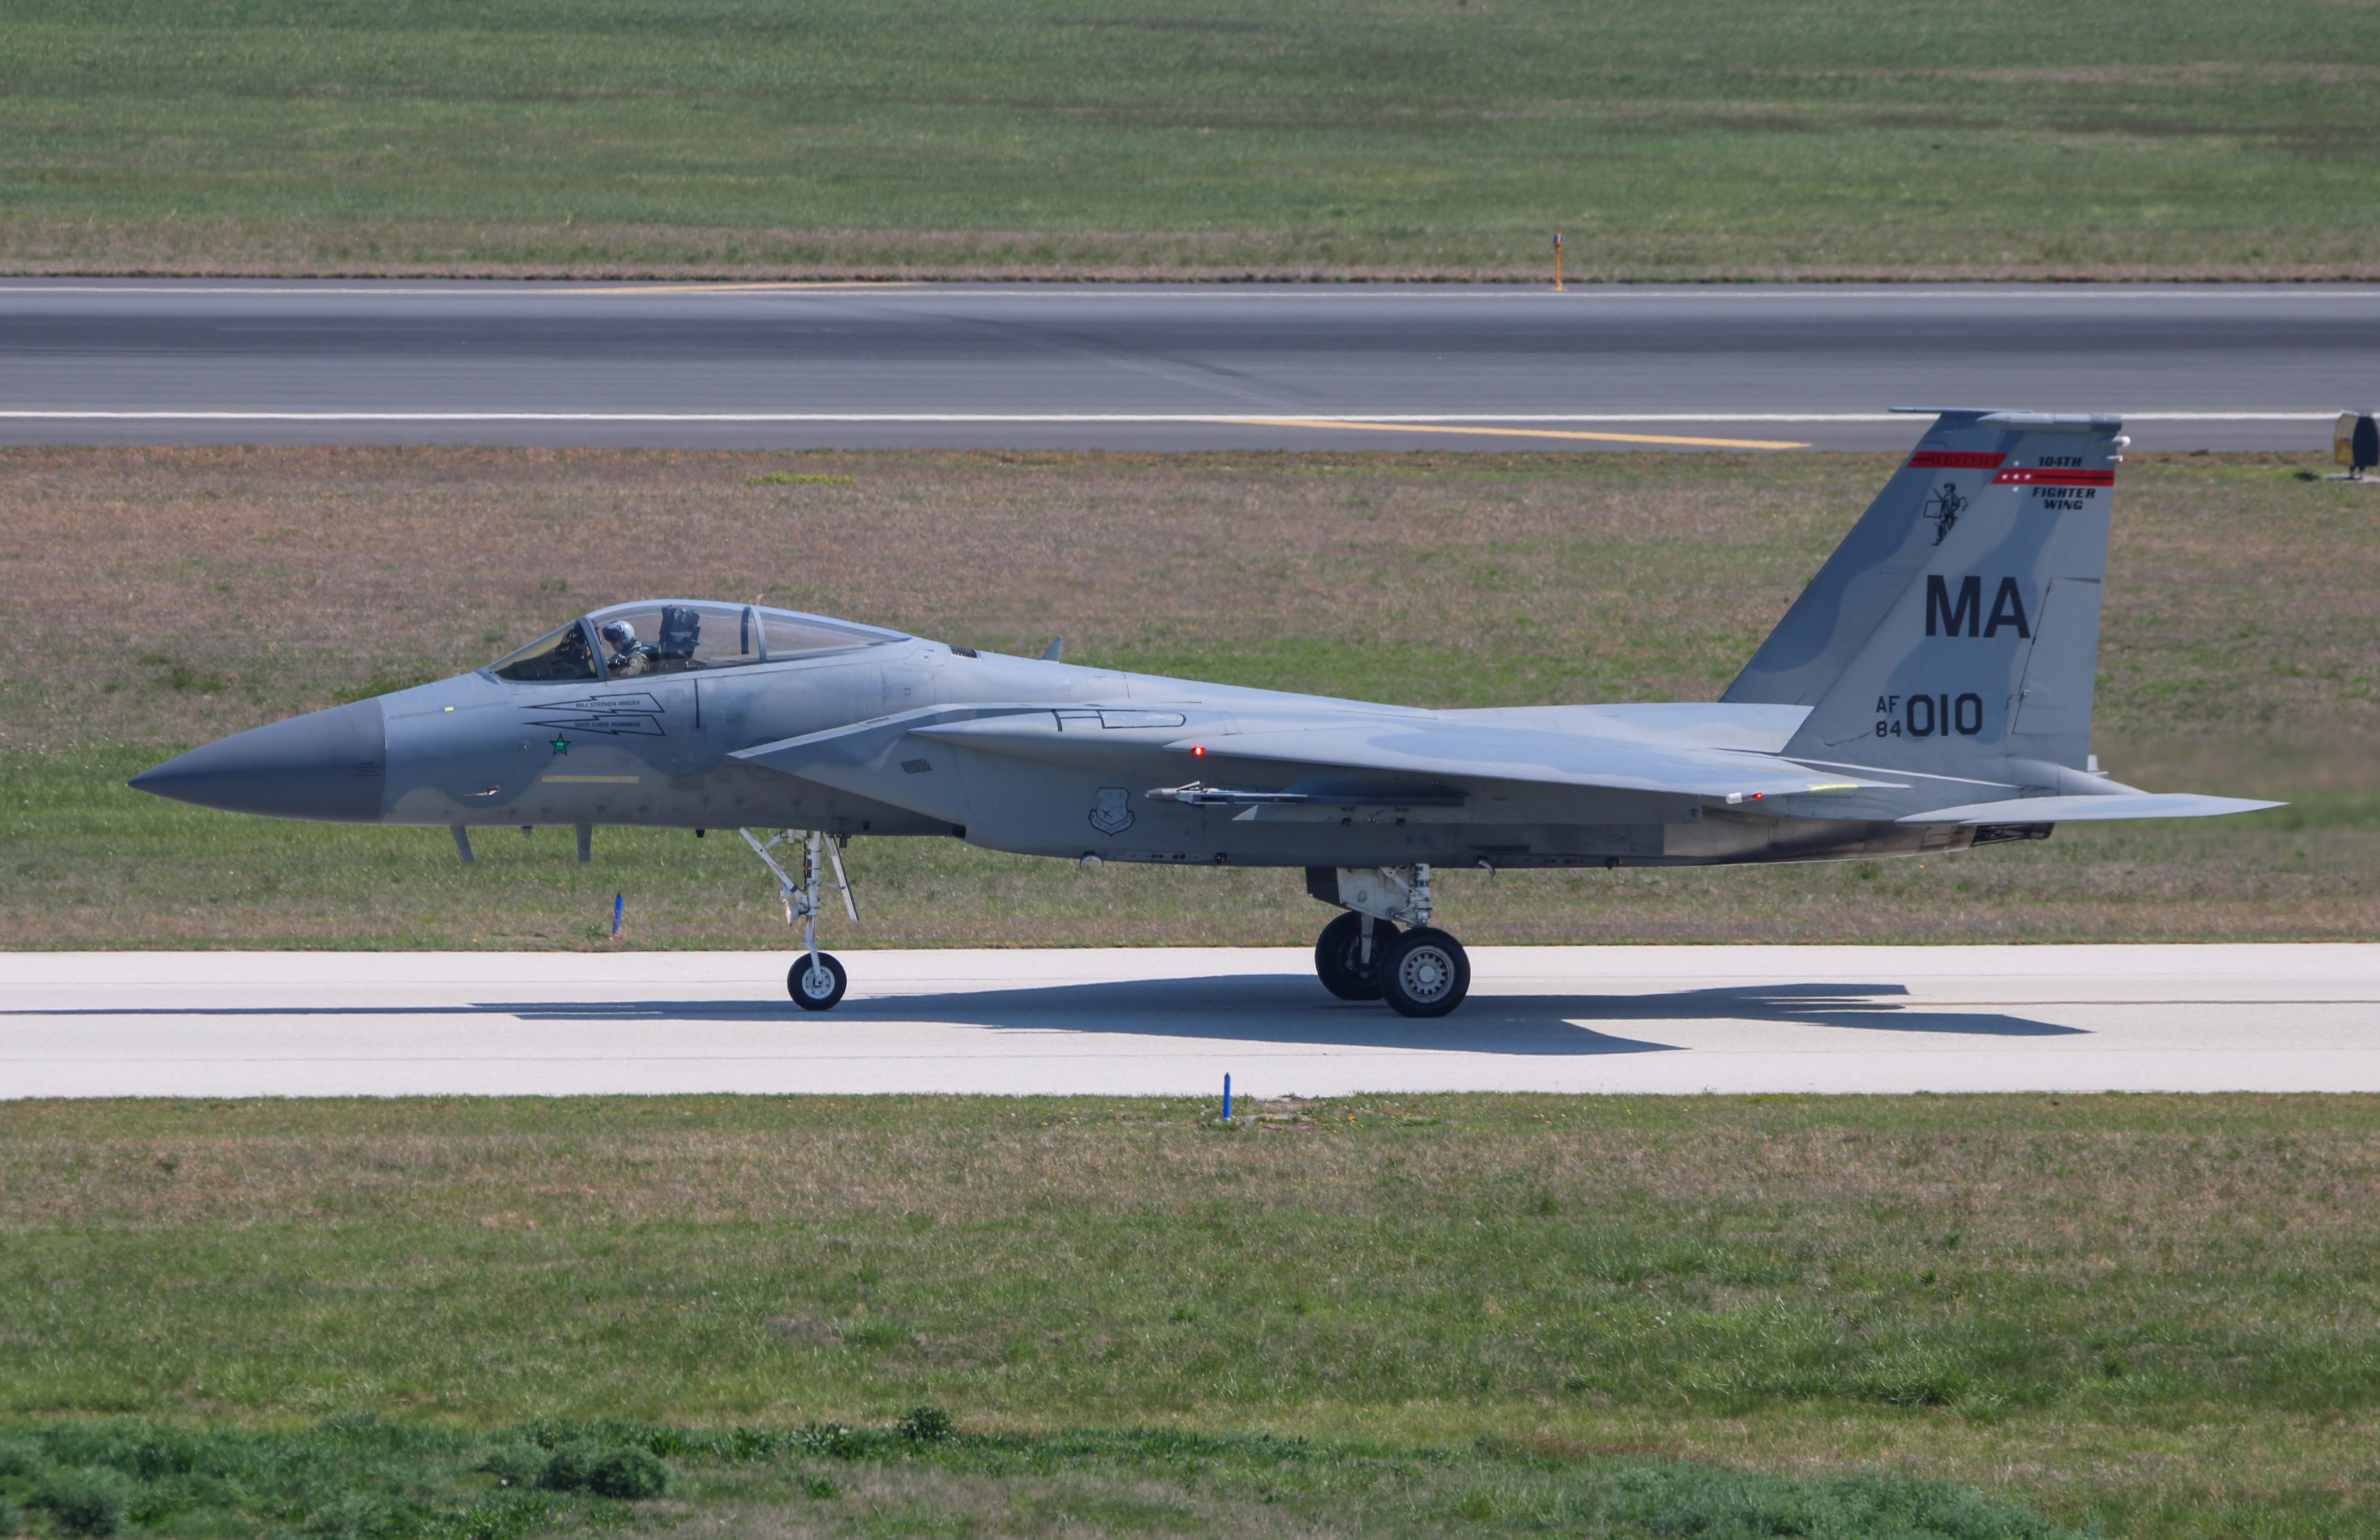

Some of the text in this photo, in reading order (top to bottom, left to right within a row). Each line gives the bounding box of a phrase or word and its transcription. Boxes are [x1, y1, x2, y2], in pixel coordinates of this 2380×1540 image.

[1931, 454, 1999, 467] WESTFIEL
[2039, 456, 2082, 467] 104TH
[2032, 487, 2096, 499] FIGHTER
[2044, 499, 2084, 510] WING
[1925, 574, 2031, 639] MA
[1876, 695, 1900, 713] AF
[1906, 692, 1983, 737] 010
[1875, 720, 1902, 738] 84
